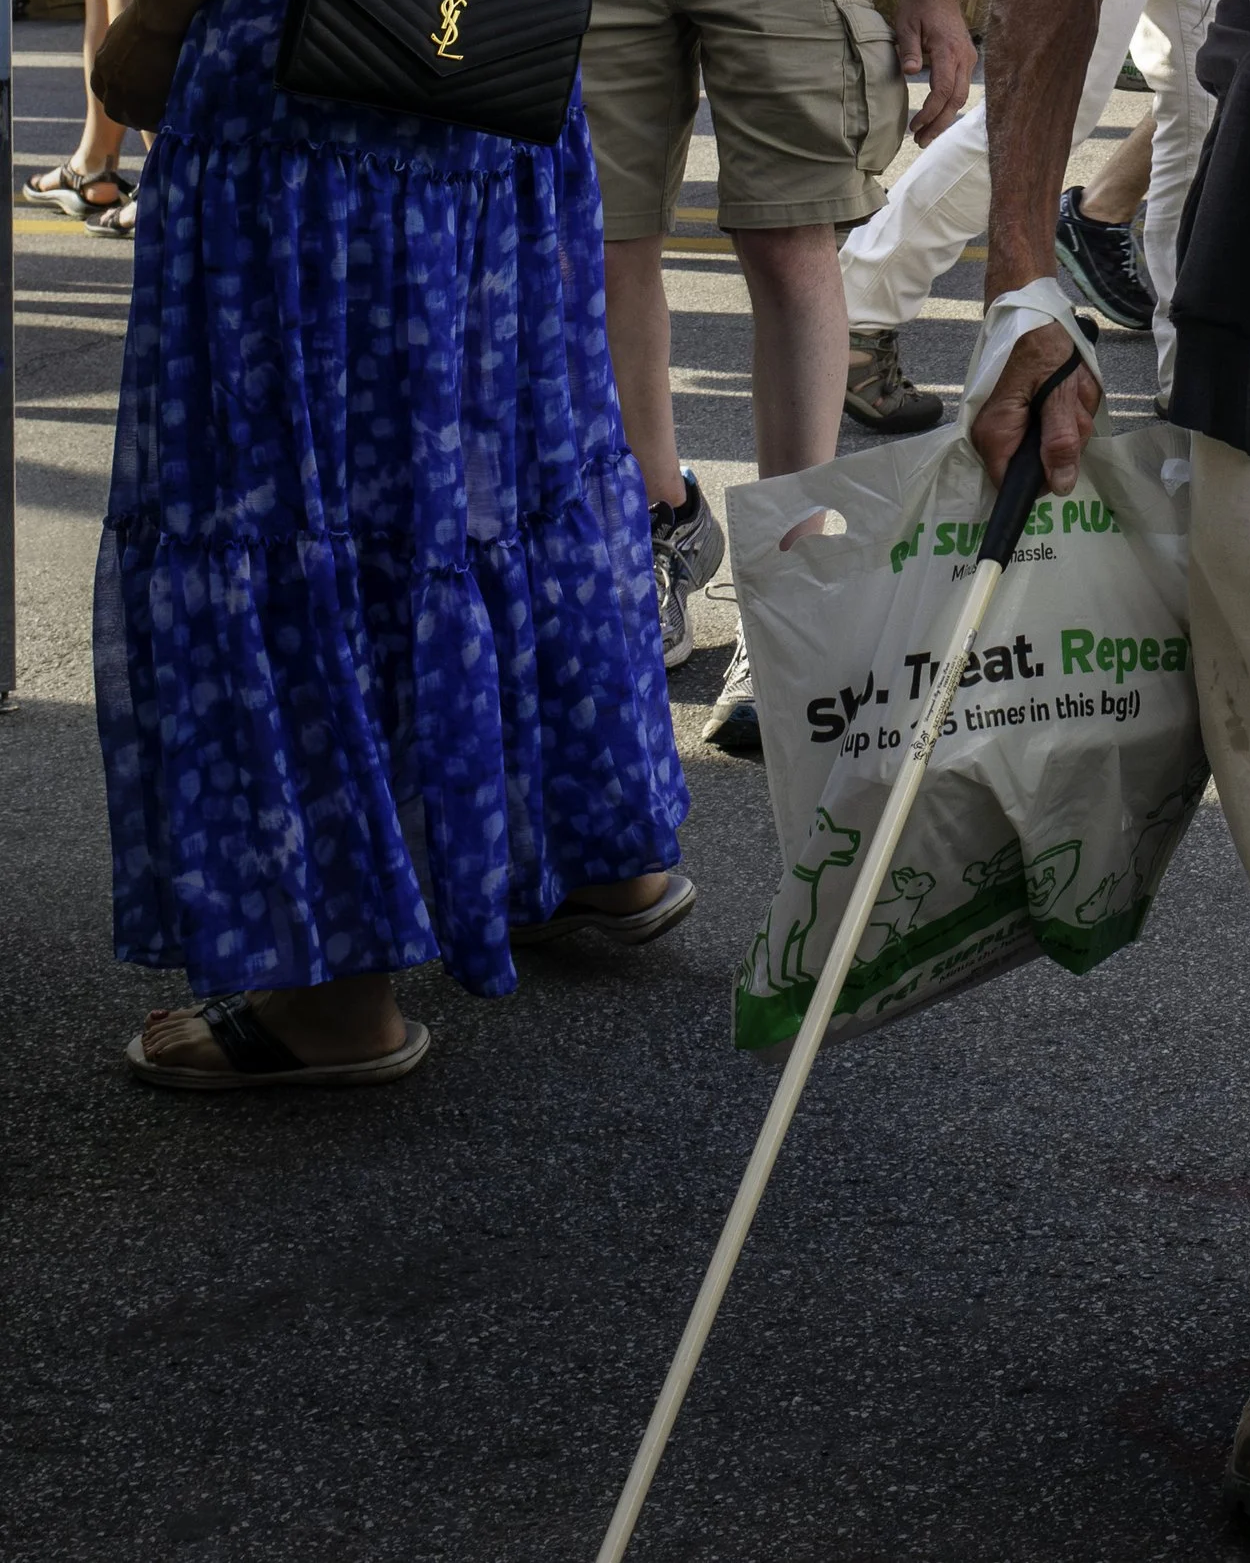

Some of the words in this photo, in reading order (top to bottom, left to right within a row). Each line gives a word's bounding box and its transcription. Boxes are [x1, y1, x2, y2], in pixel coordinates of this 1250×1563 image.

[1061, 628, 1188, 685] Repea
[877, 726, 901, 750] to
[964, 702, 1026, 731] times
[1030, 695, 1051, 723] in
[1055, 691, 1095, 719] this
[1101, 689, 1141, 723] bg!)
